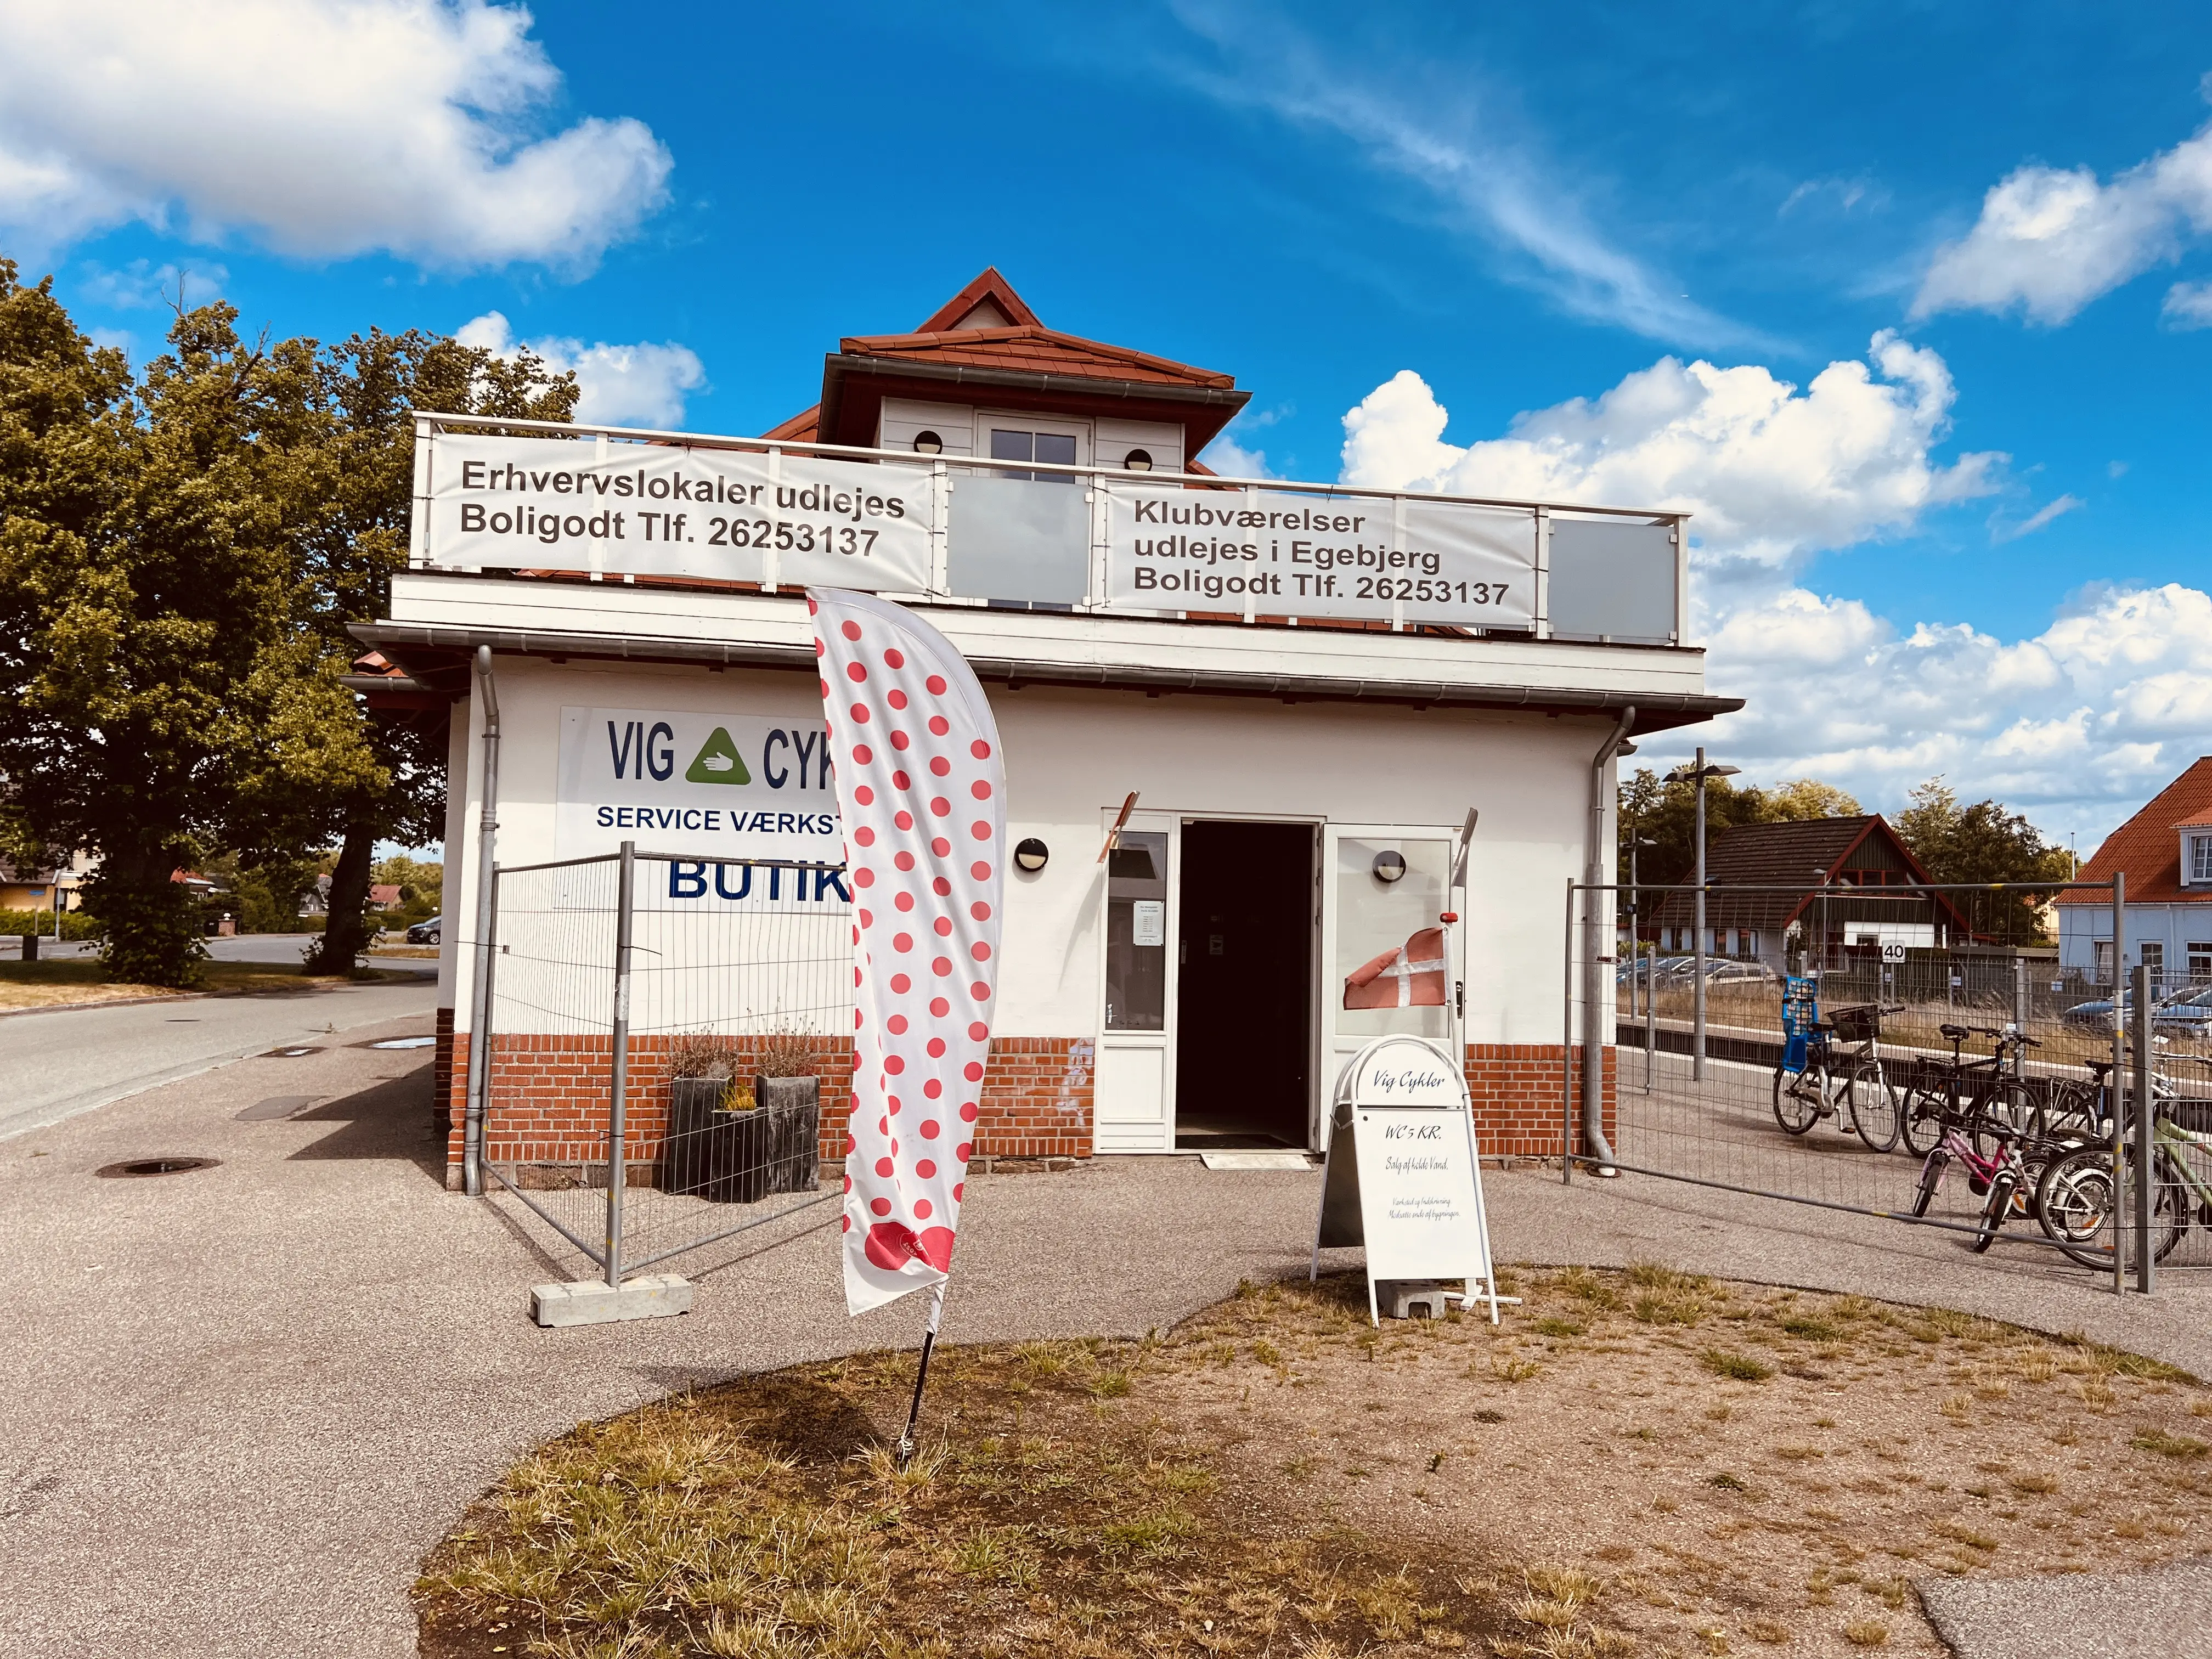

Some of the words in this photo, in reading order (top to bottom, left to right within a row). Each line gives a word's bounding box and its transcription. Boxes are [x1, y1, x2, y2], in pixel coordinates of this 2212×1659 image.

[462, 461, 764, 506] Erhvervslokaler
[777, 484, 905, 522] udlejes
[461, 503, 625, 544] Boligodt
[637, 512, 694, 543] Tlf.
[708, 517, 879, 556] 26253137
[1135, 500, 1366, 533] Klubværelser
[1135, 535, 1258, 565] udlejes
[1272, 540, 1278, 562] i
[1292, 540, 1440, 575] Egebjerg
[1135, 567, 1281, 599] Boligodt
[1292, 573, 1343, 597] Tlf.
[1356, 577, 1509, 605] 26253137
[607, 720, 674, 781] VIG
[596, 806, 720, 831] SERVICE
[669, 859, 851, 903] BUTIK
[1884, 945, 1904, 958] 40
[1374, 1070, 1397, 1093] Vig
[1399, 1071, 1445, 1094] Cykler
[1385, 1125, 1408, 1139] WC
[1408, 1128, 1415, 1139] 5
[1417, 1125, 1442, 1139] KR.
[1386, 1156, 1403, 1175] Salg
